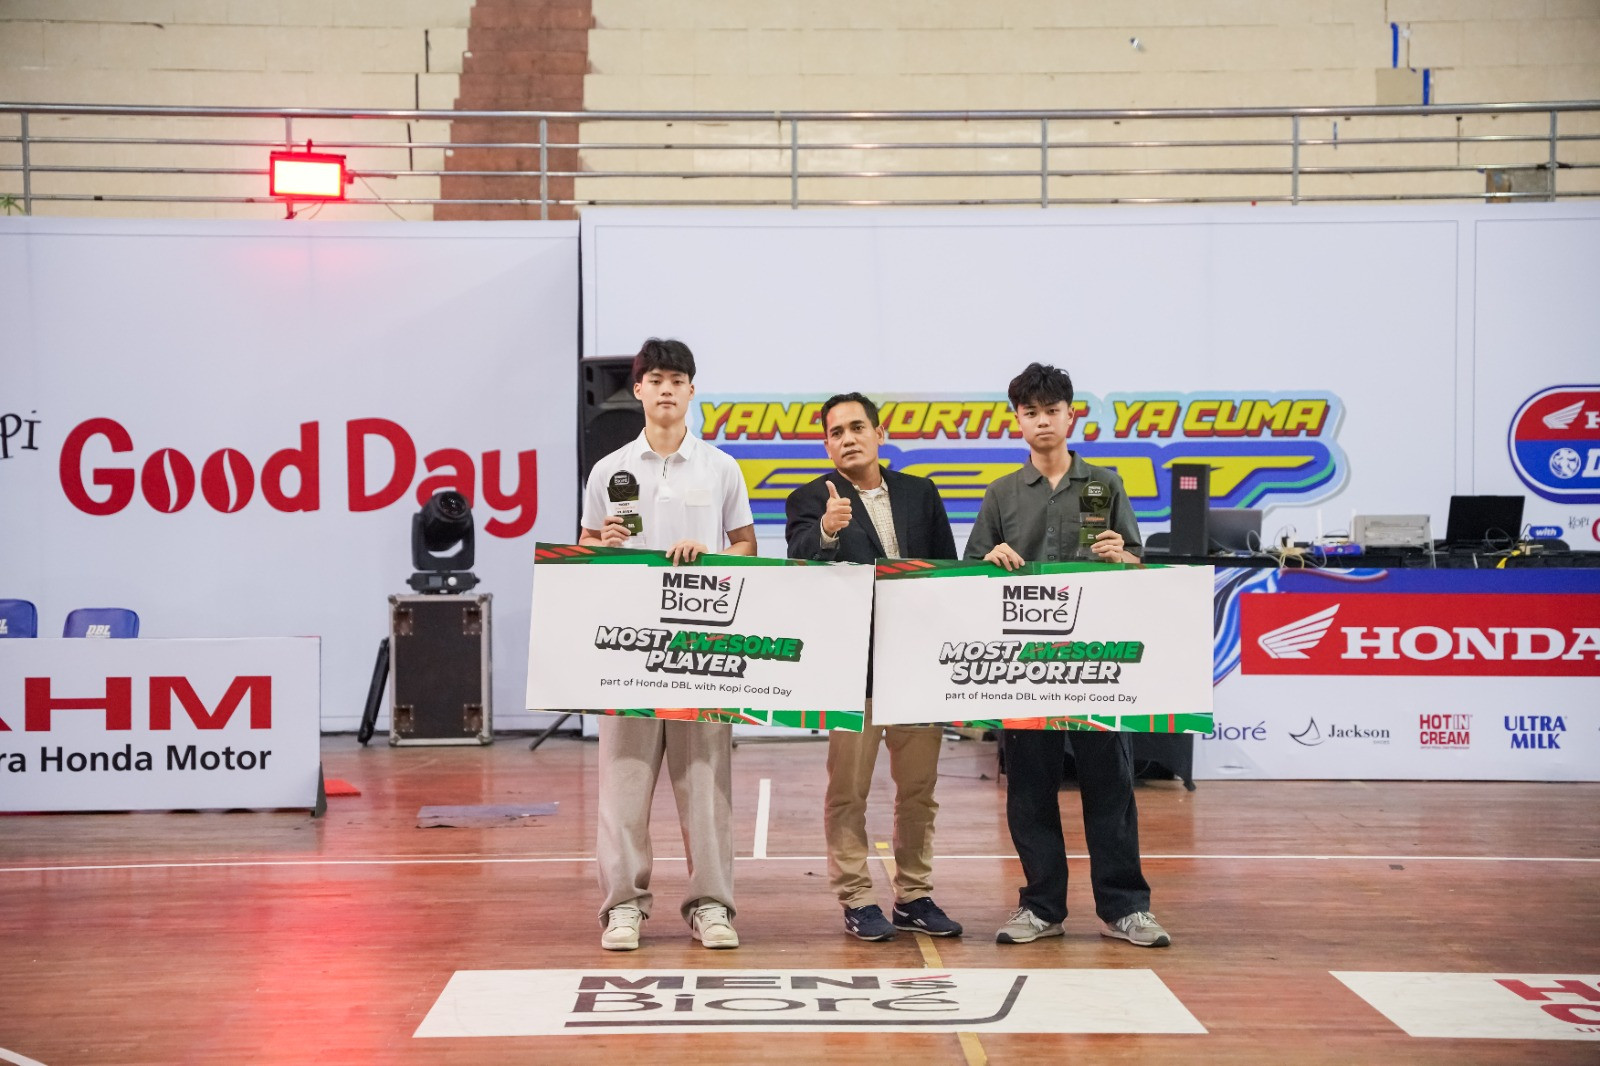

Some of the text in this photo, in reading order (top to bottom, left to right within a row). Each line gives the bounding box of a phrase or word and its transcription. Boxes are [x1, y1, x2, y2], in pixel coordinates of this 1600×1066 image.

[700, 402, 826, 440] YANG
[878, 401, 1022, 440] ORTH
[1113, 400, 1181, 438] YA
[1183, 399, 1331, 437] CUMA
[59, 417, 538, 538] Good Day
[1536, 526, 1558, 537] with
[661, 589, 729, 614] Bioré
[1002, 601, 1069, 623] Bioré
[86, 624, 111, 636] DBL
[595, 625, 804, 662] MOST AWESOME
[939, 641, 1145, 664] MOST AWESOME
[1340, 625, 1600, 661] HONDA
[645, 650, 748, 678] PLAYER
[951, 661, 1121, 685] SUPPORTER
[600, 678, 792, 697] part of Honda DBL with Kopi Good Day
[945, 691, 1138, 705] part of Honda DBL with Kopi Good Day
[1328, 724, 1391, 739] Jackson
[1504, 715, 1567, 732] ULTRA
[1420, 731, 1470, 745] CREAM
[1510, 733, 1561, 750] MILK
[40, 744, 153, 773] Honda
[166, 744, 272, 771] Motor
[570, 990, 960, 1013] Bioré
